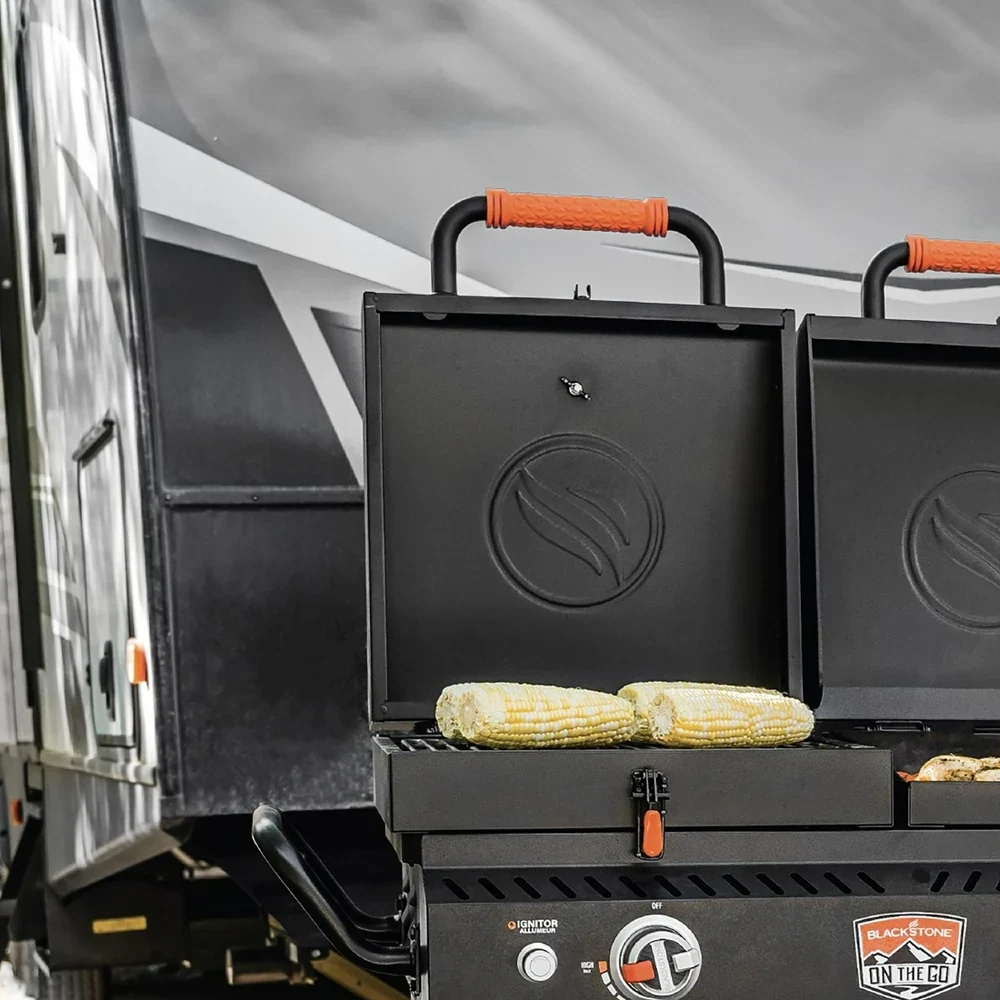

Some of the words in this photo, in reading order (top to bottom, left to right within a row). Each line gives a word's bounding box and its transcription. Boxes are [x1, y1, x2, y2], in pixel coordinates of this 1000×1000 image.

[517, 919, 558, 928] IGNITOR
[867, 927, 953, 940] BLACKSTONE
[869, 966, 892, 984] ON
[897, 966, 924, 981] THE
[927, 965, 949, 983] GO
